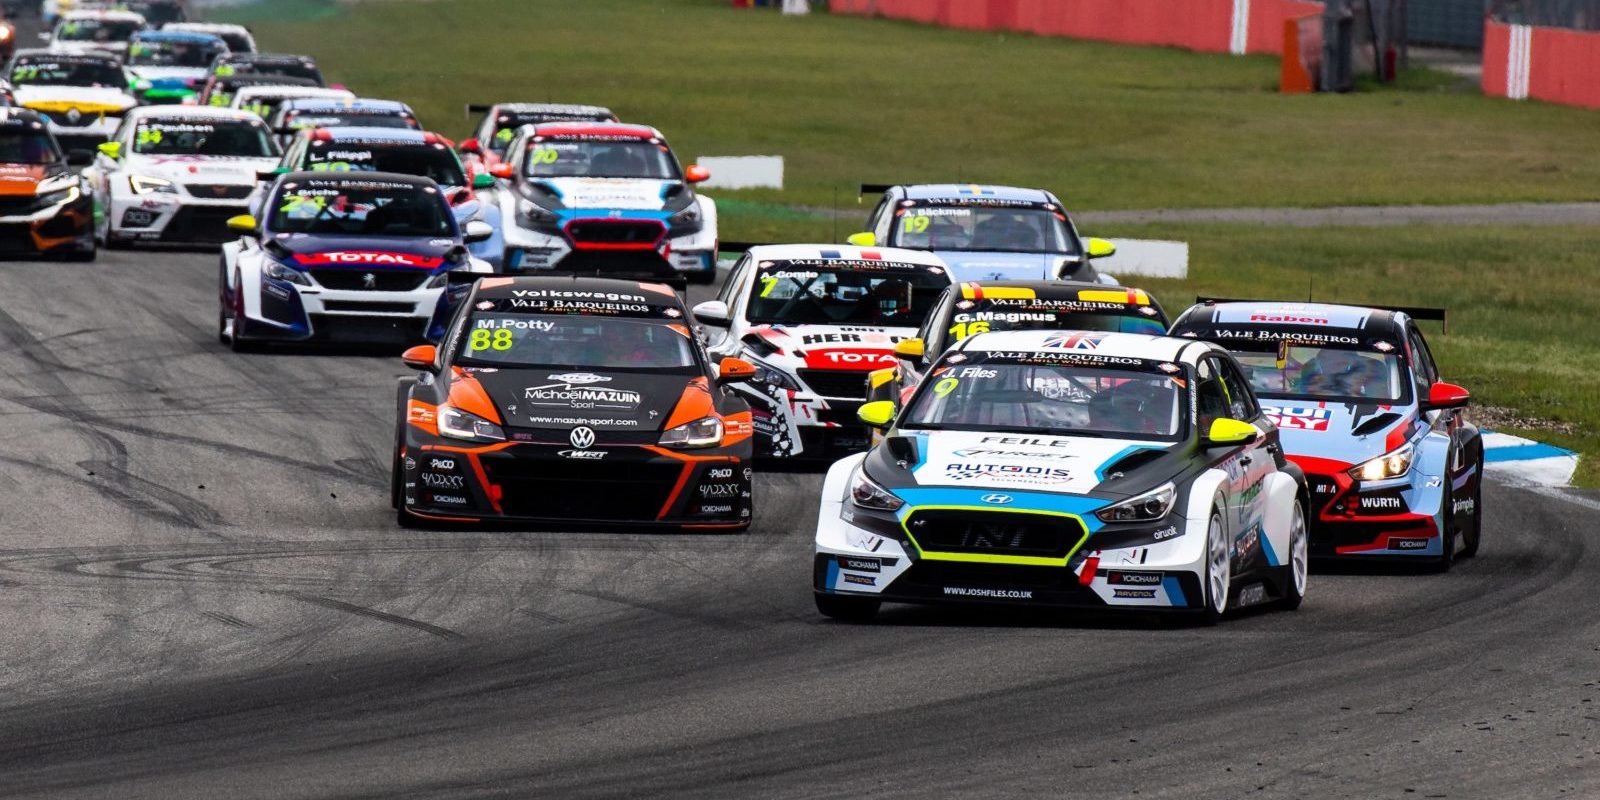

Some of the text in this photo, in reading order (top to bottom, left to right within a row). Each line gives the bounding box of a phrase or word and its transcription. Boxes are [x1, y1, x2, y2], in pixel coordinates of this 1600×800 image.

[533, 150, 558, 166] 70
[903, 208, 970, 216] A. Bäckman
[903, 216, 930, 233] 19
[323, 252, 414, 264] TOTAL
[827, 259, 915, 269] BARQUEIROS
[758, 278, 778, 298] 7
[512, 290, 646, 302] Volkswagen
[510, 299, 649, 312] VALE BARQUEIROS
[1032, 299, 1125, 310] BARQUEIROS
[954, 312, 1056, 323] G.Magnus
[1250, 315, 1328, 324] Raben
[477, 319, 555, 332] M.Potty
[948, 321, 990, 341] 16
[470, 328, 513, 351] 88
[1215, 330, 1253, 338] VALE
[1258, 330, 1359, 344] BARQUEIROS
[824, 352, 899, 362] TOTA
[987, 352, 1142, 365] VALE BARQUEIROS
[942, 367, 997, 379] J. Files
[934, 377, 959, 399] 9
[570, 400, 594, 409] Sport
[530, 416, 638, 426] www.mazuin-sport.com
[981, 437, 1070, 447] FEILE
[946, 464, 1070, 476] AUTODIS
[433, 495, 466, 503] YOKOHAMA
[1362, 497, 1400, 508] WÜRTH
[1456, 497, 1474, 512] simple
[847, 560, 879, 569] YOKOHAMA
[1123, 575, 1160, 583] YOKOHAMA
[944, 587, 1032, 598] WWW.JOSHFILES.CO.UK
